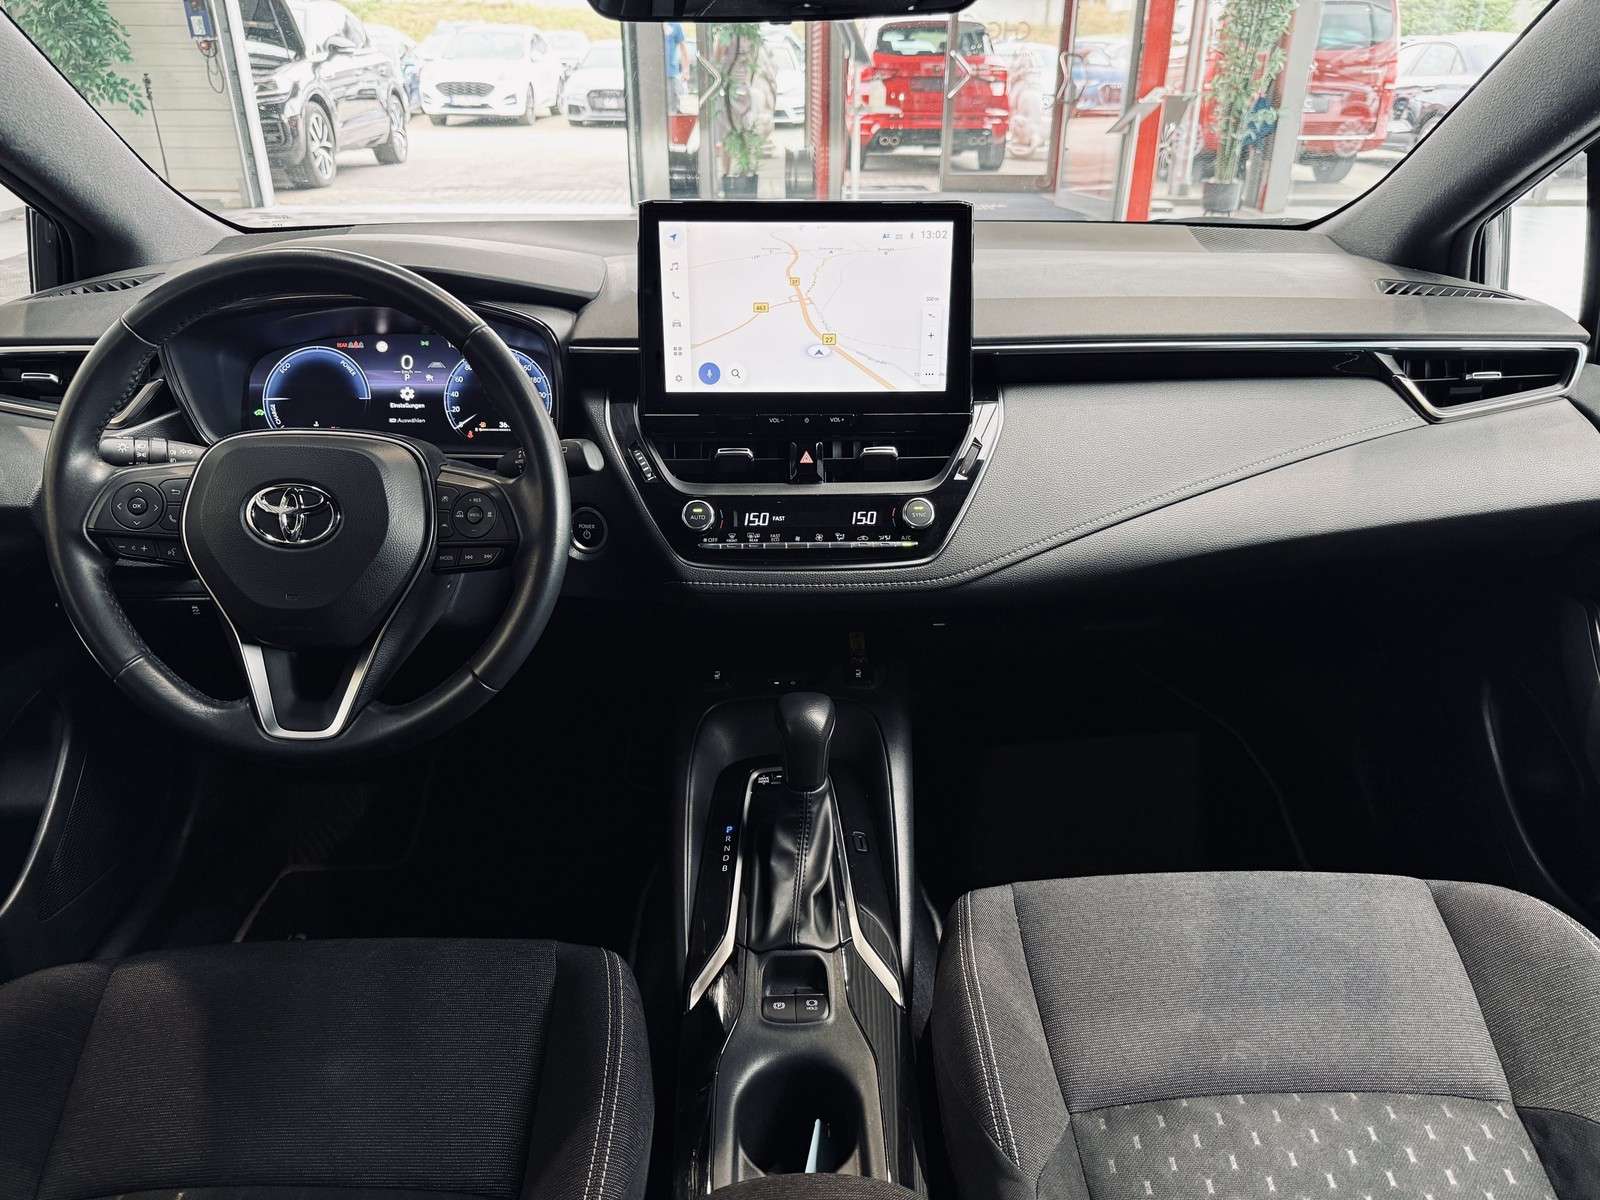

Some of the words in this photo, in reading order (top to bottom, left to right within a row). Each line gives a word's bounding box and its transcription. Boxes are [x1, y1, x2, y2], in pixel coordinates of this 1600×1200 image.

[920, 230, 948, 240] 13:02
[279, 361, 291, 374] ECO
[339, 359, 357, 377] POWER
[400, 354, 414, 370] 0
